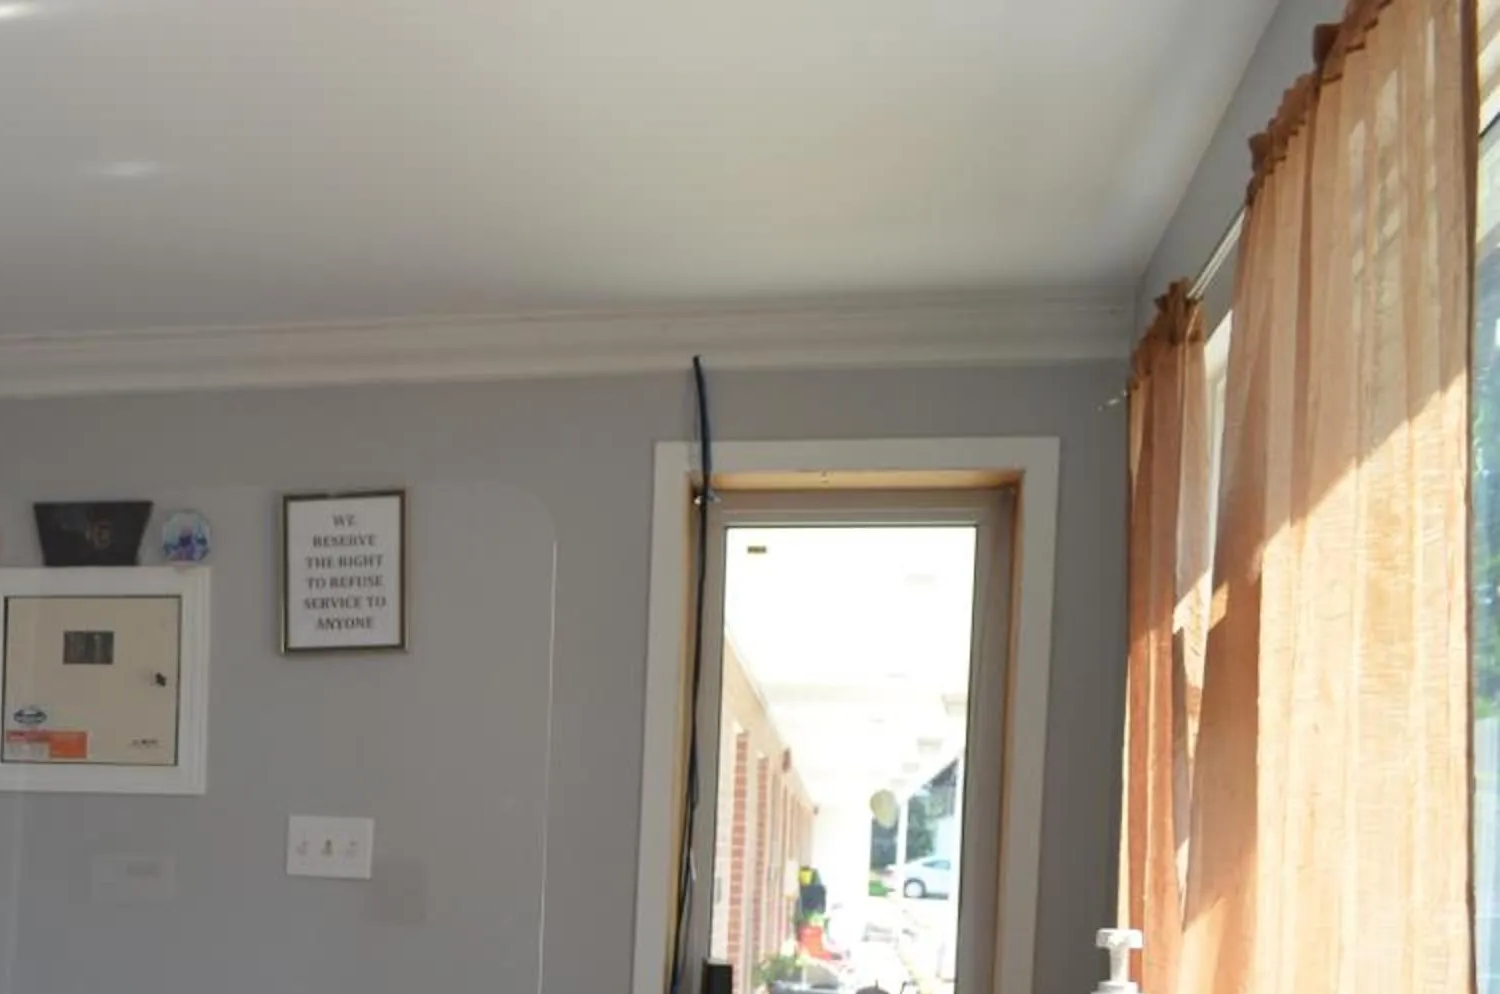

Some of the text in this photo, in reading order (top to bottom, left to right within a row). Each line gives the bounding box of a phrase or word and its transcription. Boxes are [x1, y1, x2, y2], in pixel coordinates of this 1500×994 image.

[332, 514, 356, 527] WE
[312, 534, 376, 548] RESERVE
[305, 553, 384, 568] THE RIGHT
[306, 574, 384, 588] TO REFUSE
[304, 595, 387, 609] SERVICE TO
[316, 616, 374, 631] ANYONE
